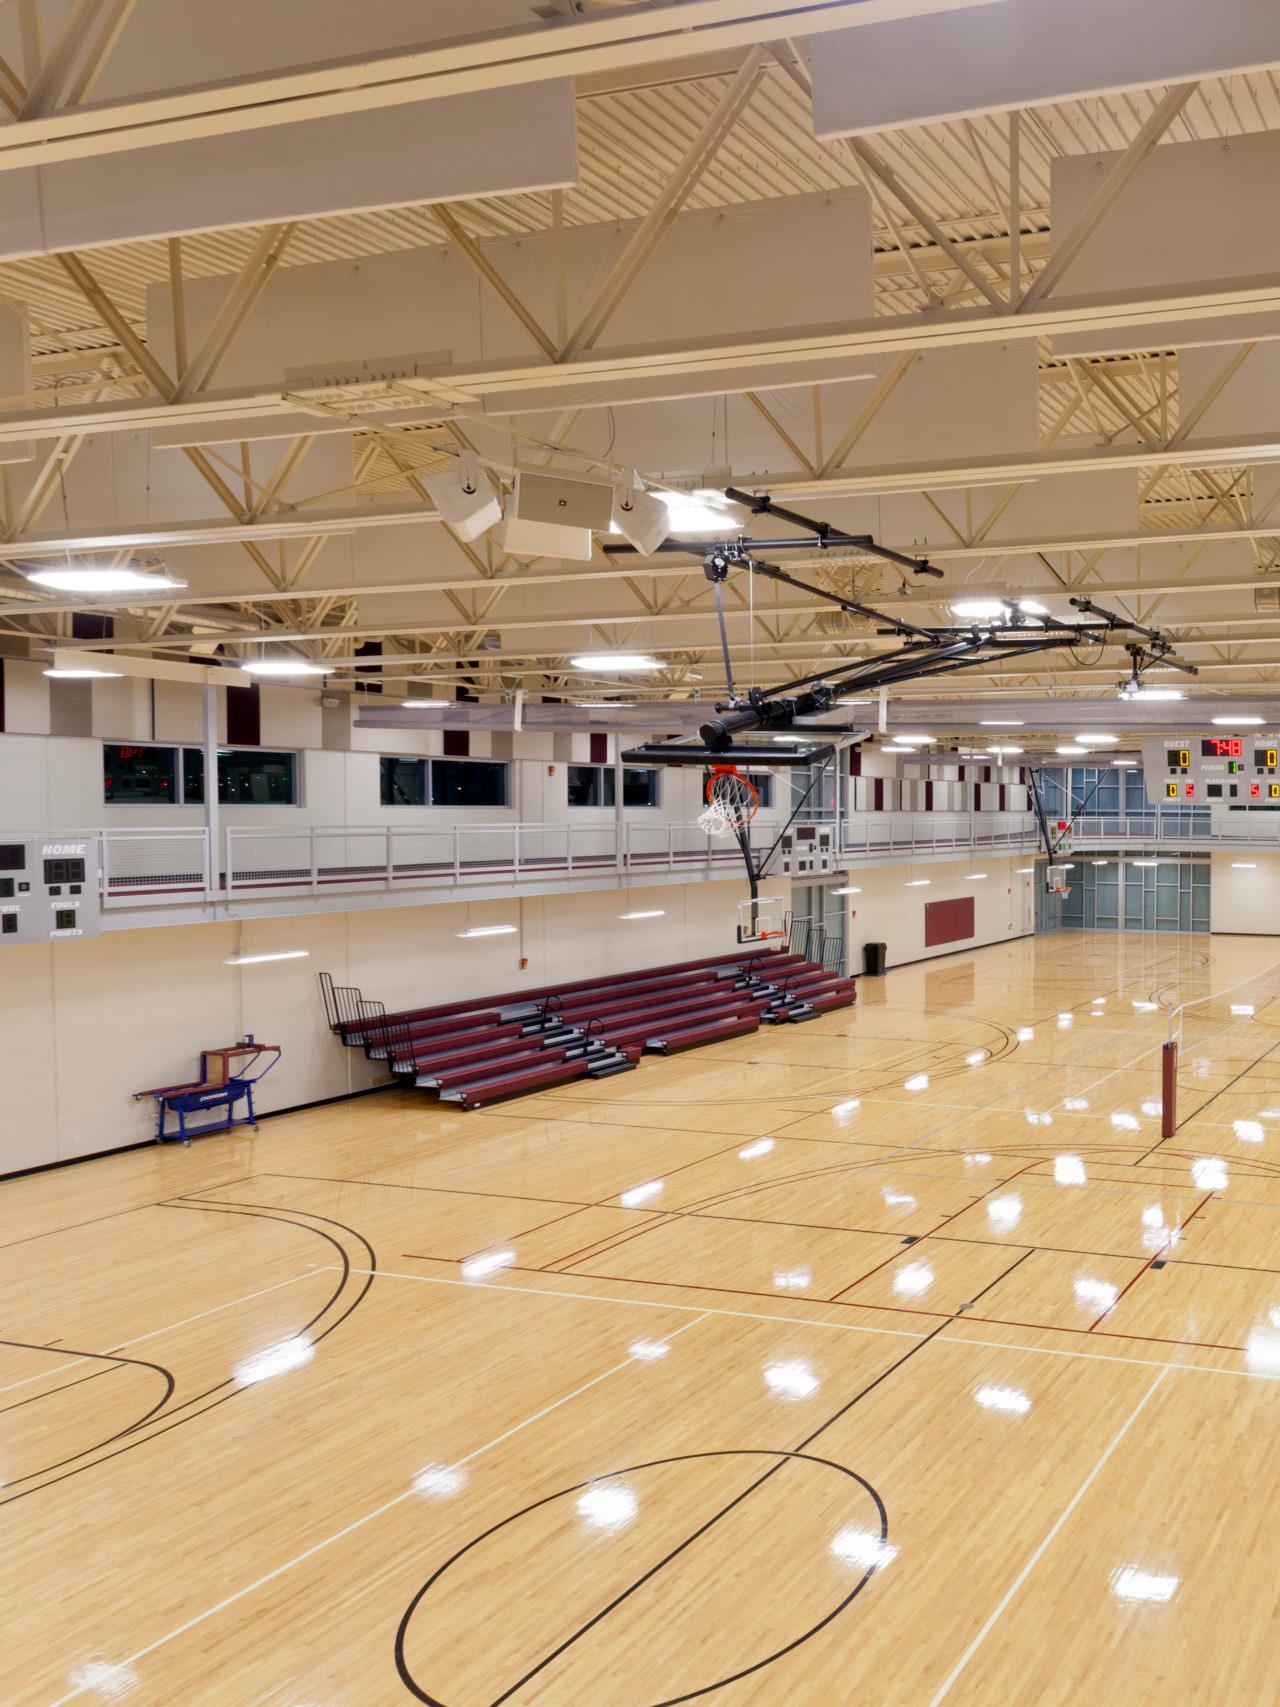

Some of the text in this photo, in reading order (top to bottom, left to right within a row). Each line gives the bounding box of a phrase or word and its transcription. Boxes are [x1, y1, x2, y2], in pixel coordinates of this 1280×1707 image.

[1163, 740, 1190, 748] GUEST
[1211, 739, 1242, 756] 7:48
[1180, 750, 1189, 766] 0
[1267, 750, 1277, 766] 0
[1186, 783, 1194, 797] 5
[1251, 783, 1260, 797] 5
[42, 844, 87, 855] HOME
[51, 901, 81, 910] FOULS
[49, 929, 84, 938] POINTS
